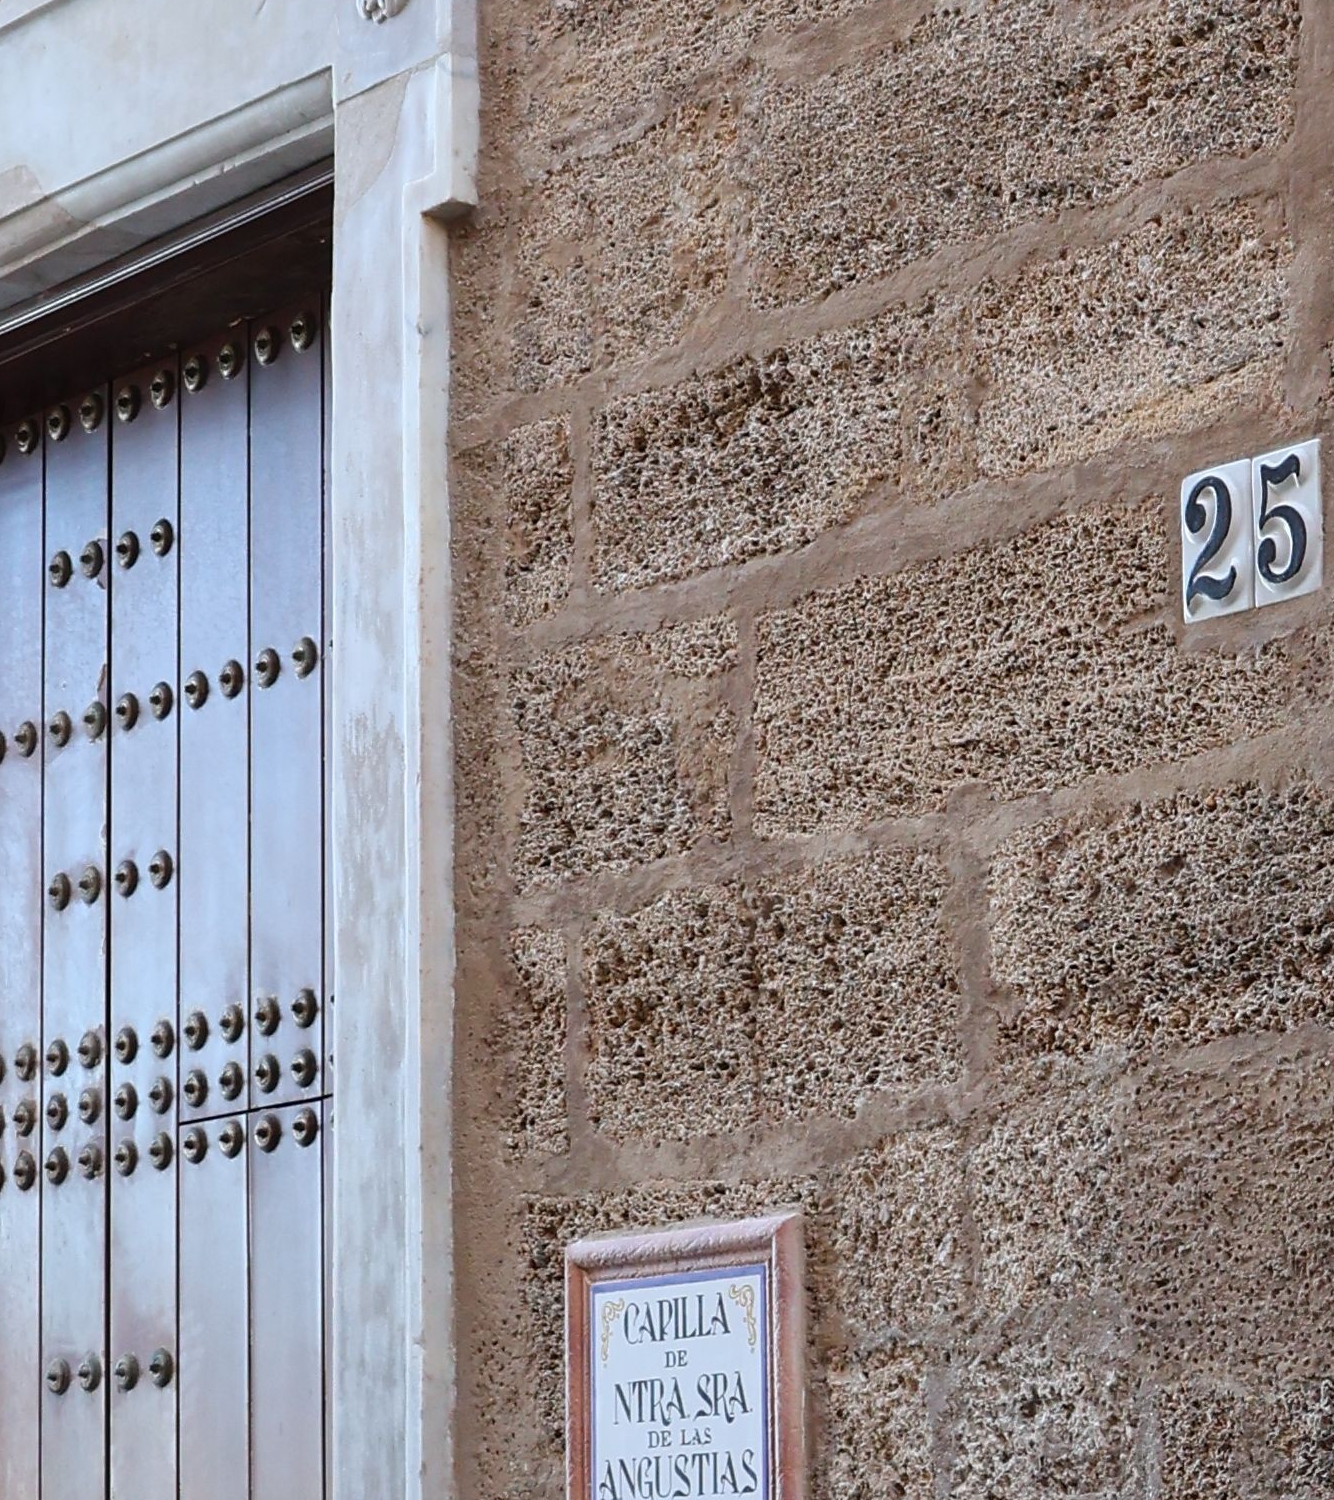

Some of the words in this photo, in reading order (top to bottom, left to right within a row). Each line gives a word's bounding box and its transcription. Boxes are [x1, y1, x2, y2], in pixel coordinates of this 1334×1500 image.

[1185, 454, 1307, 607] 25
[624, 1292, 731, 1345] CAPILLA
[664, 1350, 688, 1368] DE
[614, 1377, 690, 1427] NTRA.
[693, 1371, 753, 1424] SRA.
[648, 1430, 672, 1449] DE
[680, 1427, 712, 1446] LAS
